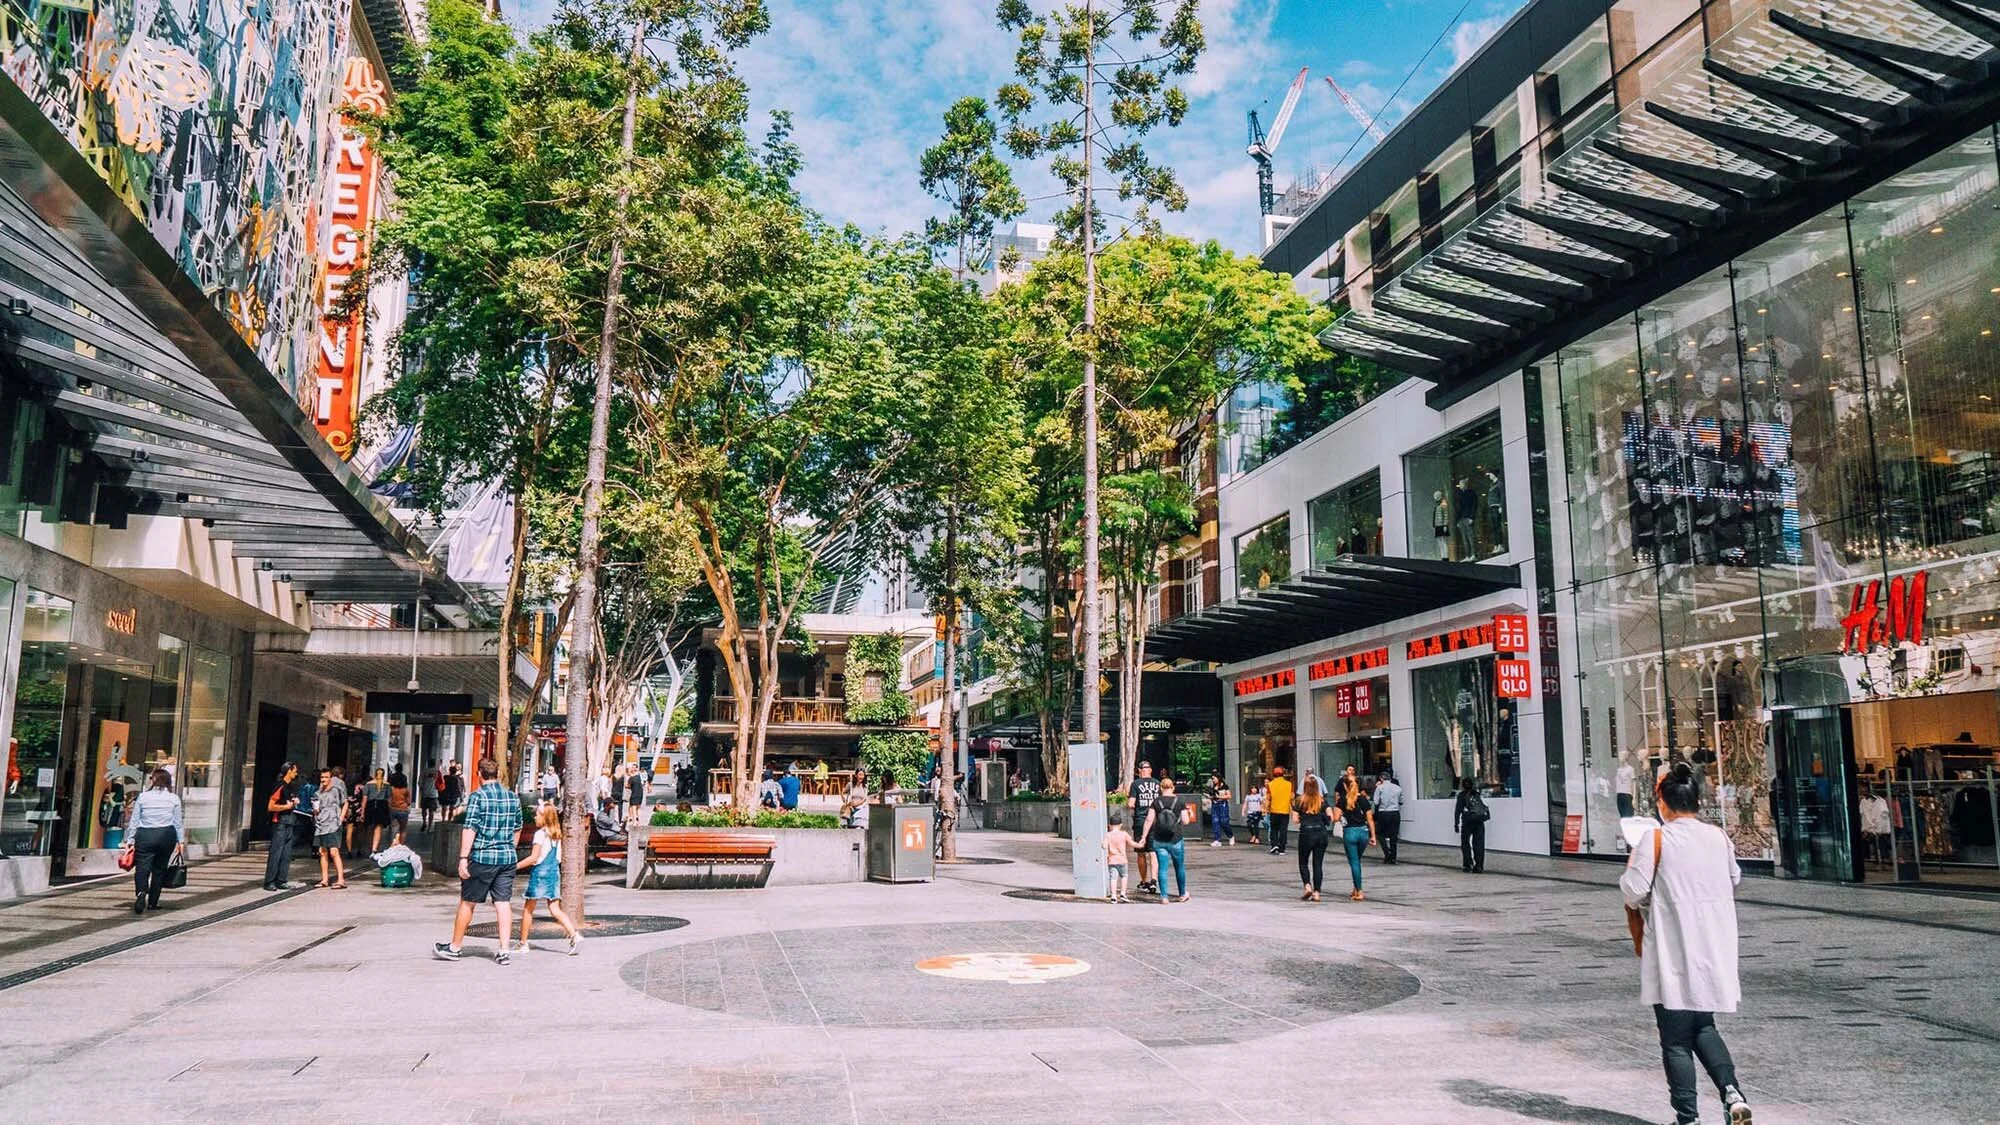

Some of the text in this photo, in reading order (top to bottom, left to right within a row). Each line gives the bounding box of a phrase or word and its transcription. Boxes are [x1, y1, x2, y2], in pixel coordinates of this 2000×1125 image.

[318, 127, 366, 421] REGENT
[1840, 570, 1926, 655] H&M
[107, 607, 136, 635] seed
[1501, 664, 1525, 678] UNI
[1502, 679, 1527, 694] QLO
[1139, 719, 1171, 729] colette
[1138, 781, 1159, 793] DEUS
